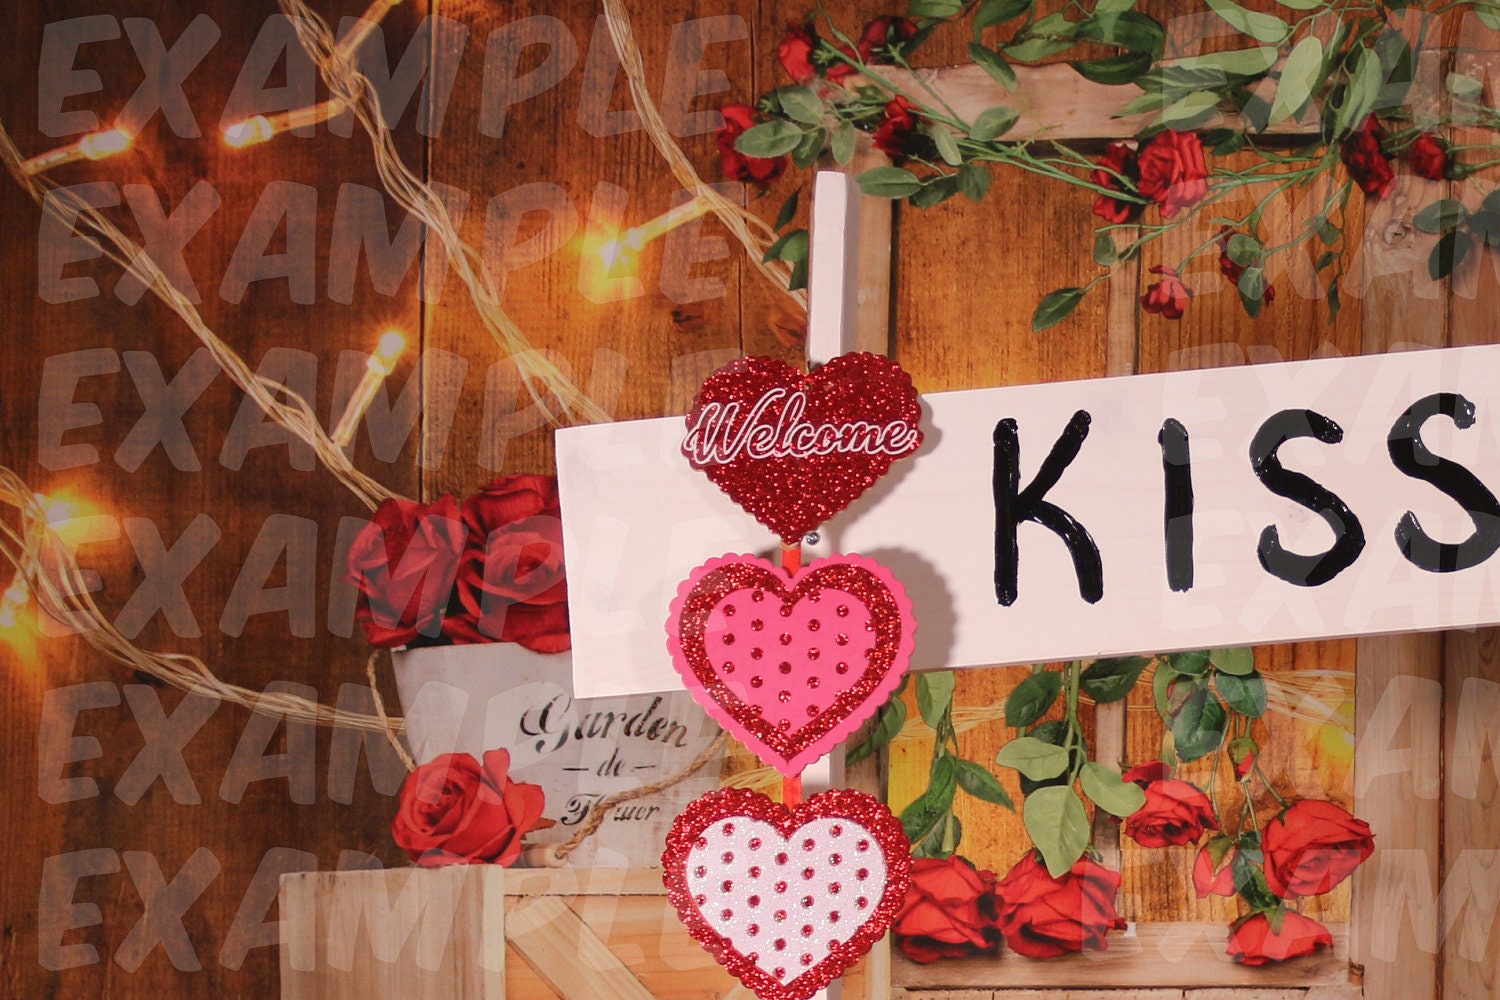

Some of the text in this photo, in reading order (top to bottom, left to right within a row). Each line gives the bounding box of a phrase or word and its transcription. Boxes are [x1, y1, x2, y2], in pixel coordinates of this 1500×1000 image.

[684, 387, 918, 465] Welcome
[519, 694, 688, 753] Garden
[596, 747, 625, 777] de
[560, 793, 661, 826] Fwer
